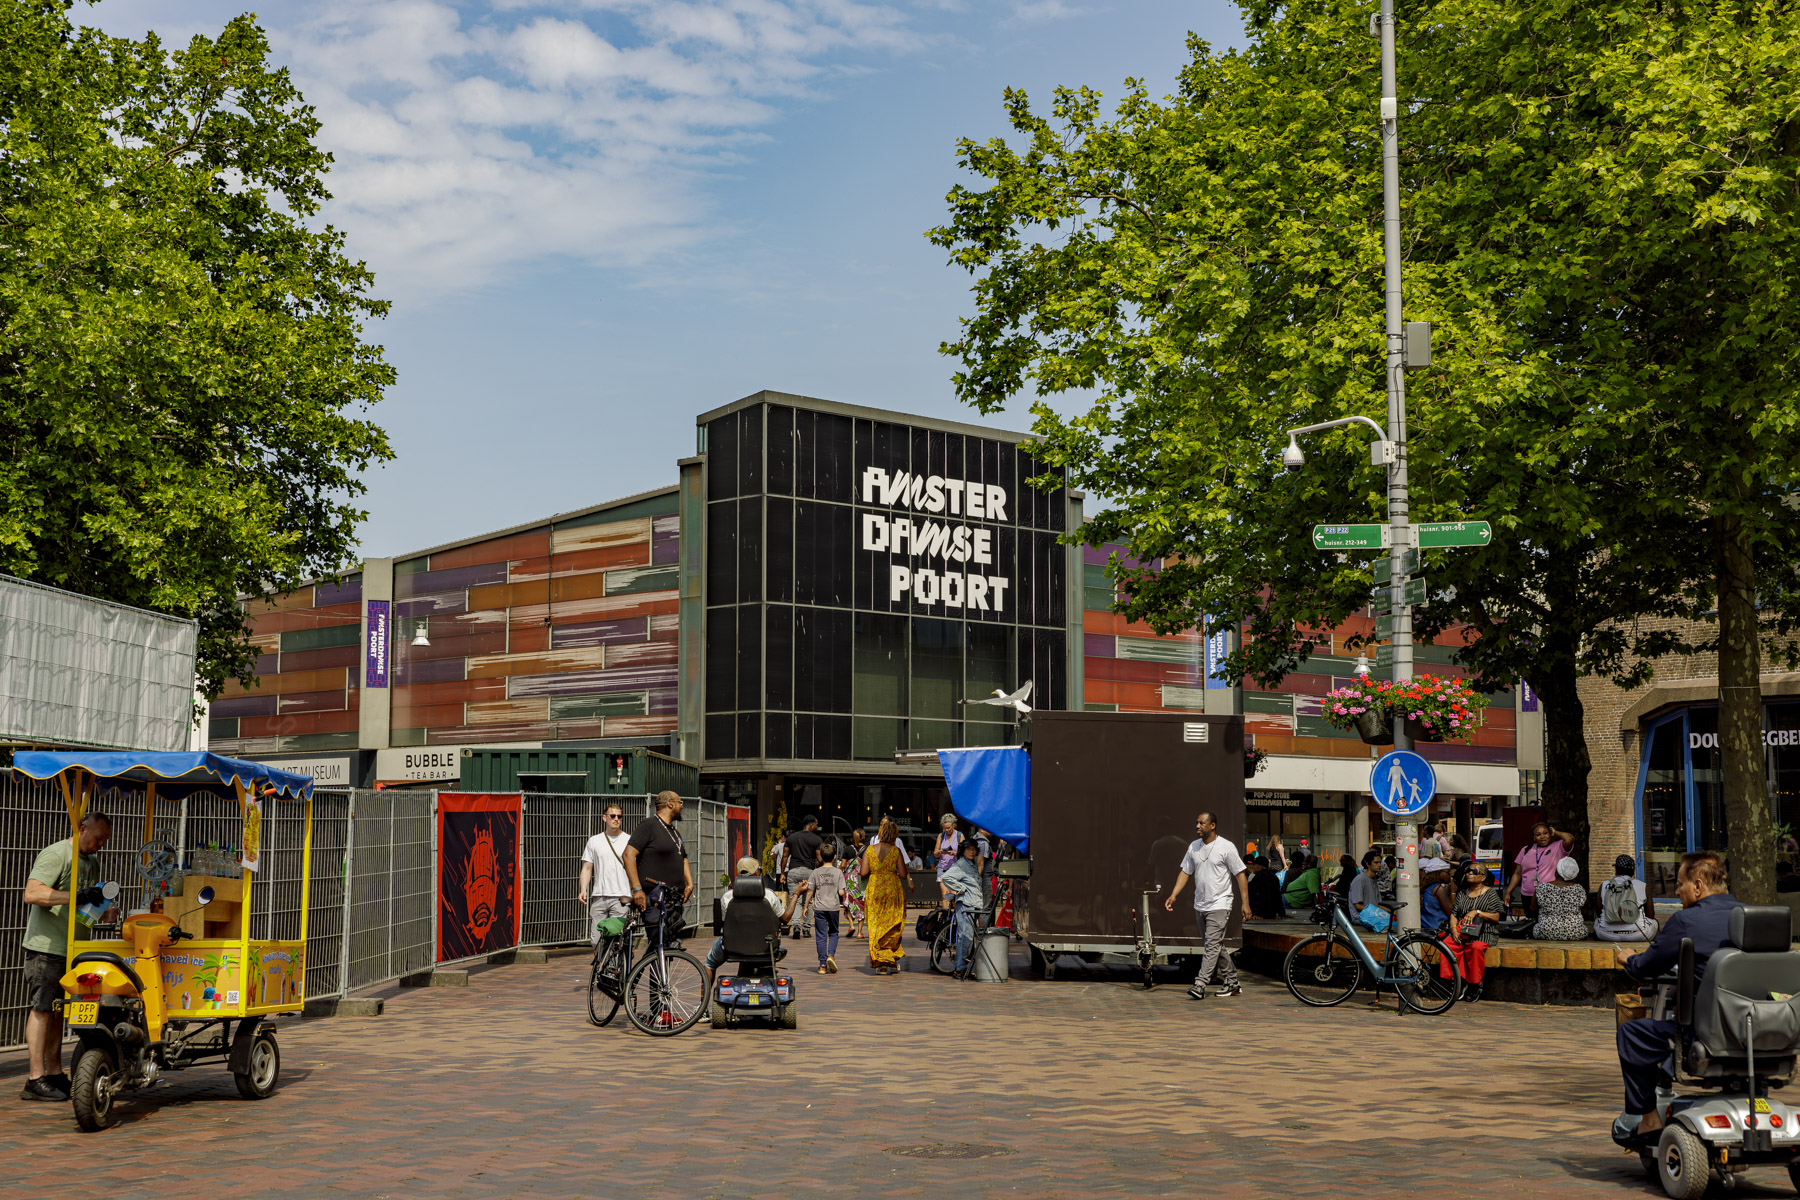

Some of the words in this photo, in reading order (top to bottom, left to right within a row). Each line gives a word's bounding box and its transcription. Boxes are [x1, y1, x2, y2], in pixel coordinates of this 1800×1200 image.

[863, 466, 1008, 521] AMSTER
[863, 513, 991, 565] DAMSE
[891, 565, 1009, 612] POORT
[377, 613, 385, 675] AMSTERDAMSE
[405, 753, 454, 768] BUBBLE
[300, 764, 340, 779] MUSEUM
[430, 771, 447, 779] BAR
[1253, 791, 1273, 799] POP-UP
[1282, 799, 1301, 807] POORT
[160, 952, 190, 965] haved
[190, 955, 205, 967] ice
[79, 1003, 96, 1013] DFP
